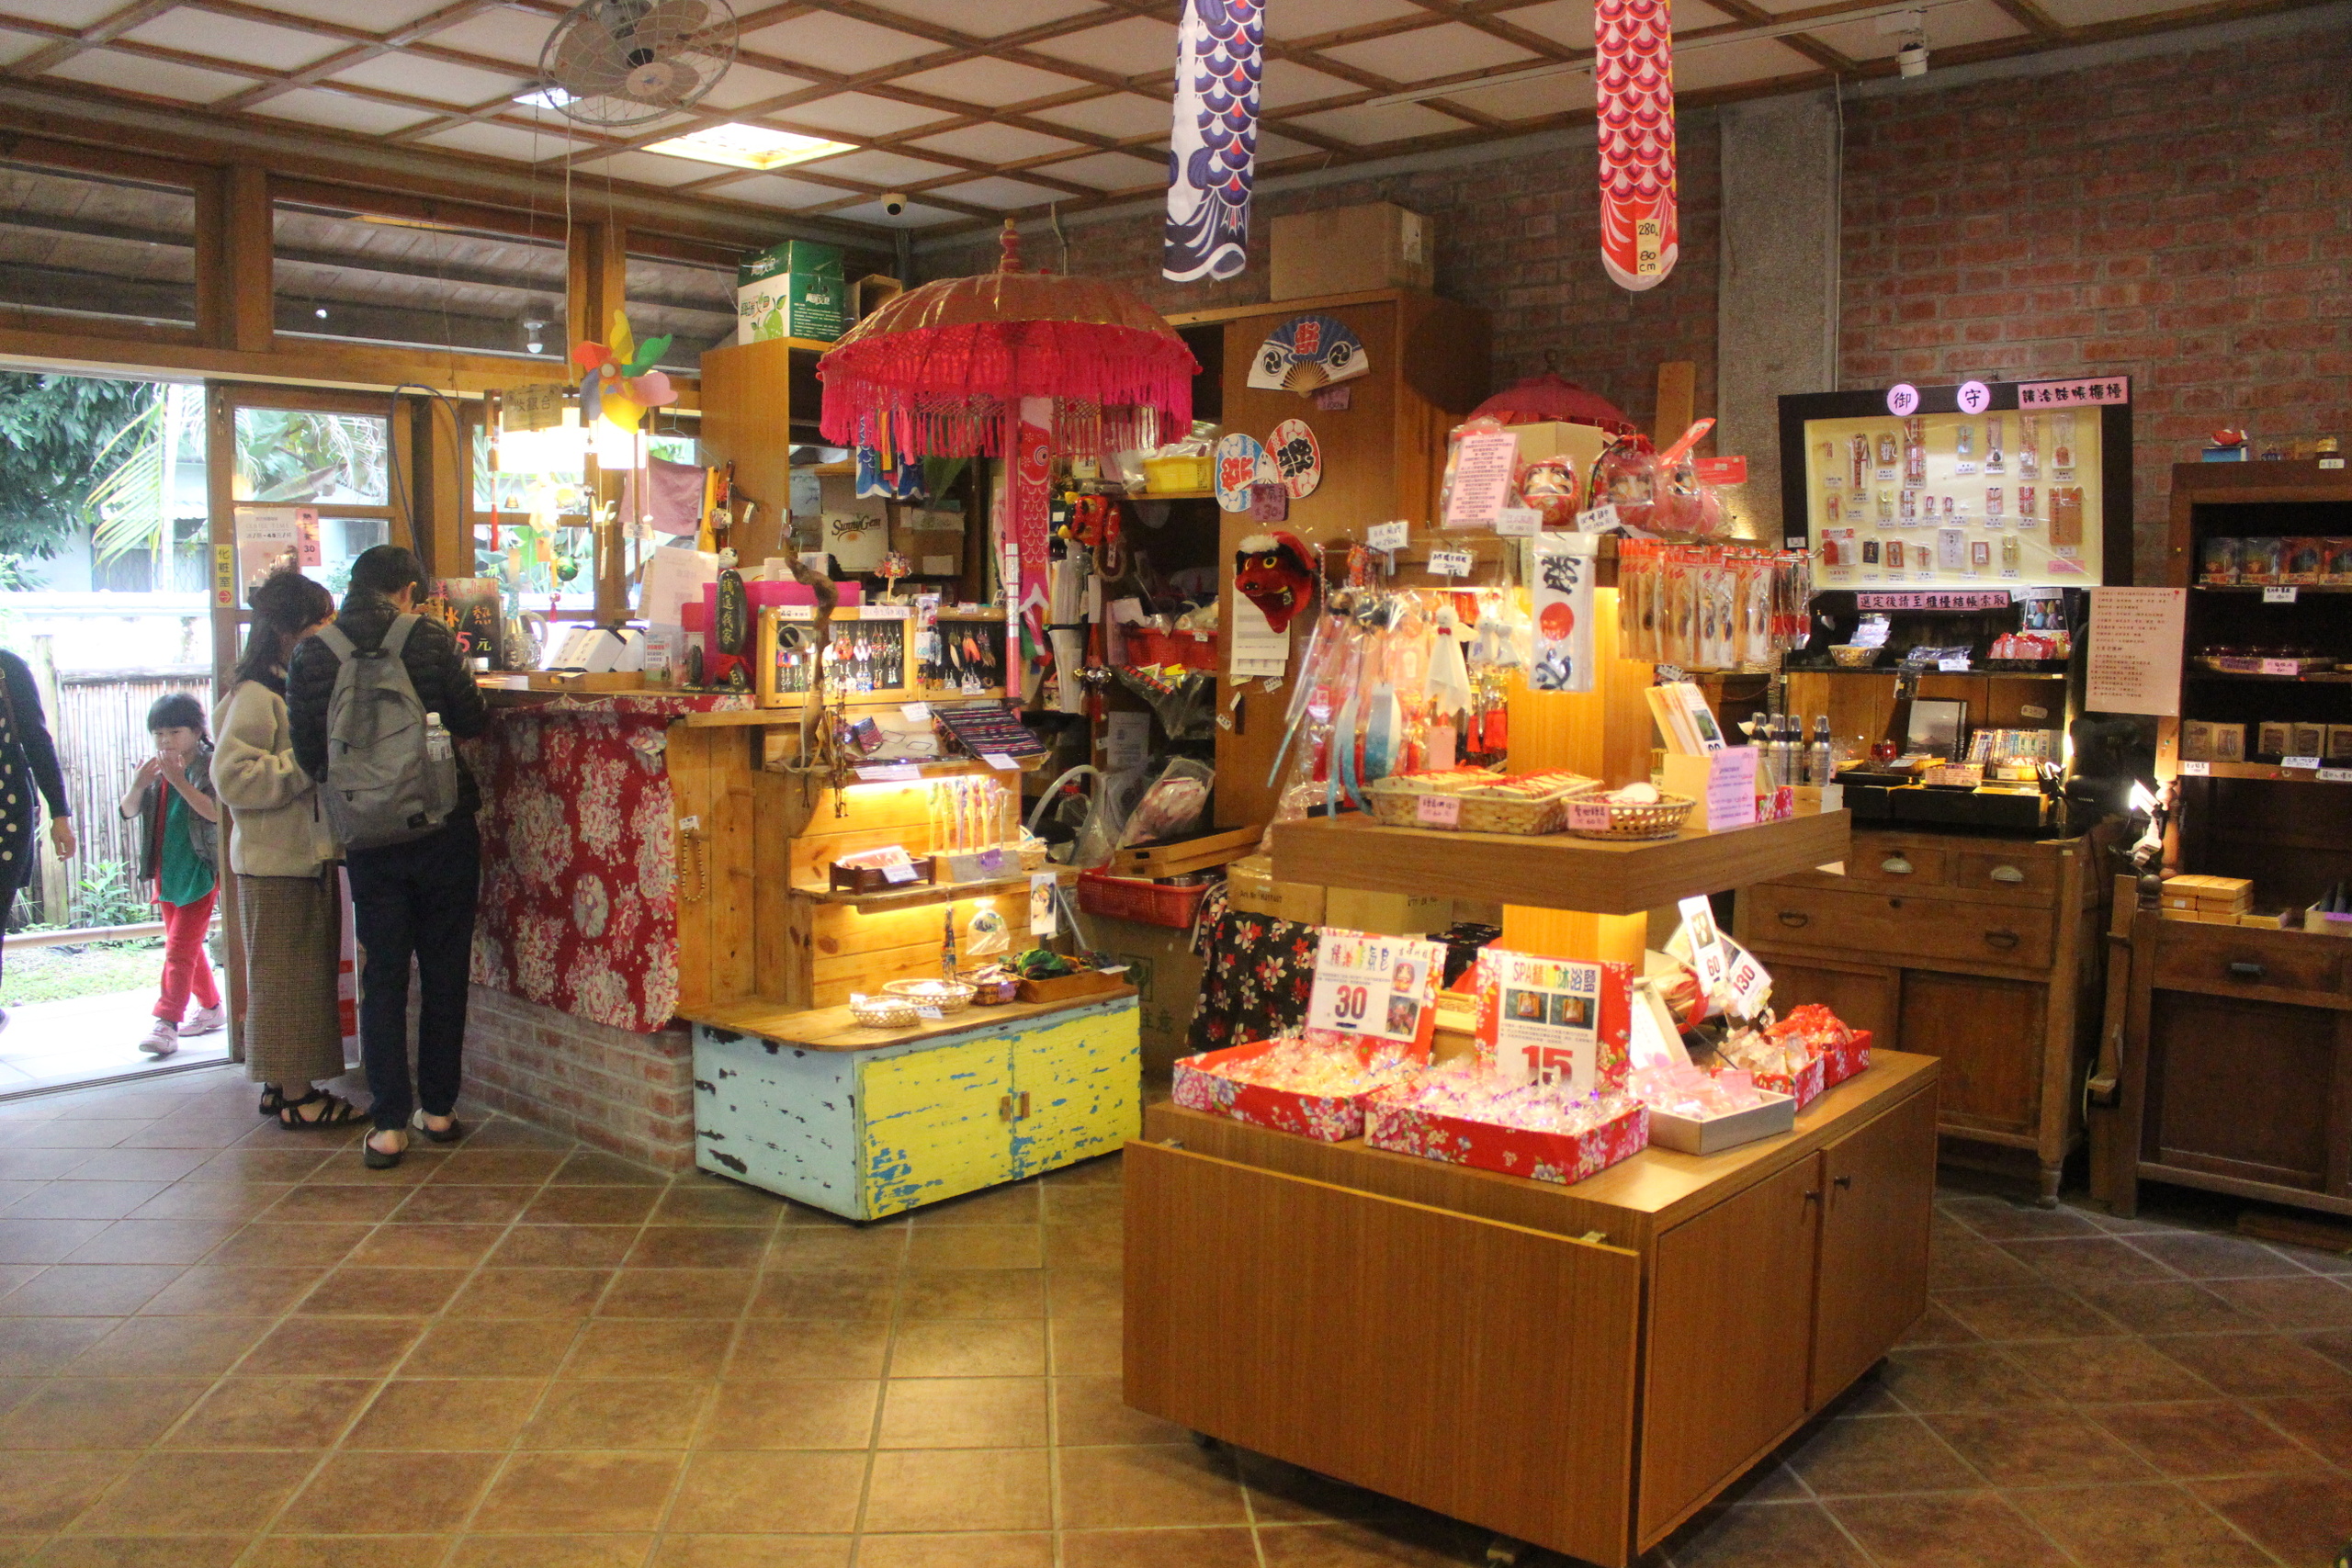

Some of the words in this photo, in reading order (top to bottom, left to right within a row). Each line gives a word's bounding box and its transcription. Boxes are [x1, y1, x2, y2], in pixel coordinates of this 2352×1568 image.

[1640, 250, 1657, 261] 80
[1639, 263, 1657, 272] cm
[1294, 321, 1321, 355] 祭
[1894, 392, 1912, 409] 御
[1964, 389, 1982, 408] 守
[304, 545, 315, 553] 30
[1706, 955, 1721, 976] 60
[1732, 964, 1756, 996] 130
[1334, 984, 1368, 1021] 30
[1521, 1044, 1574, 1086] 15
